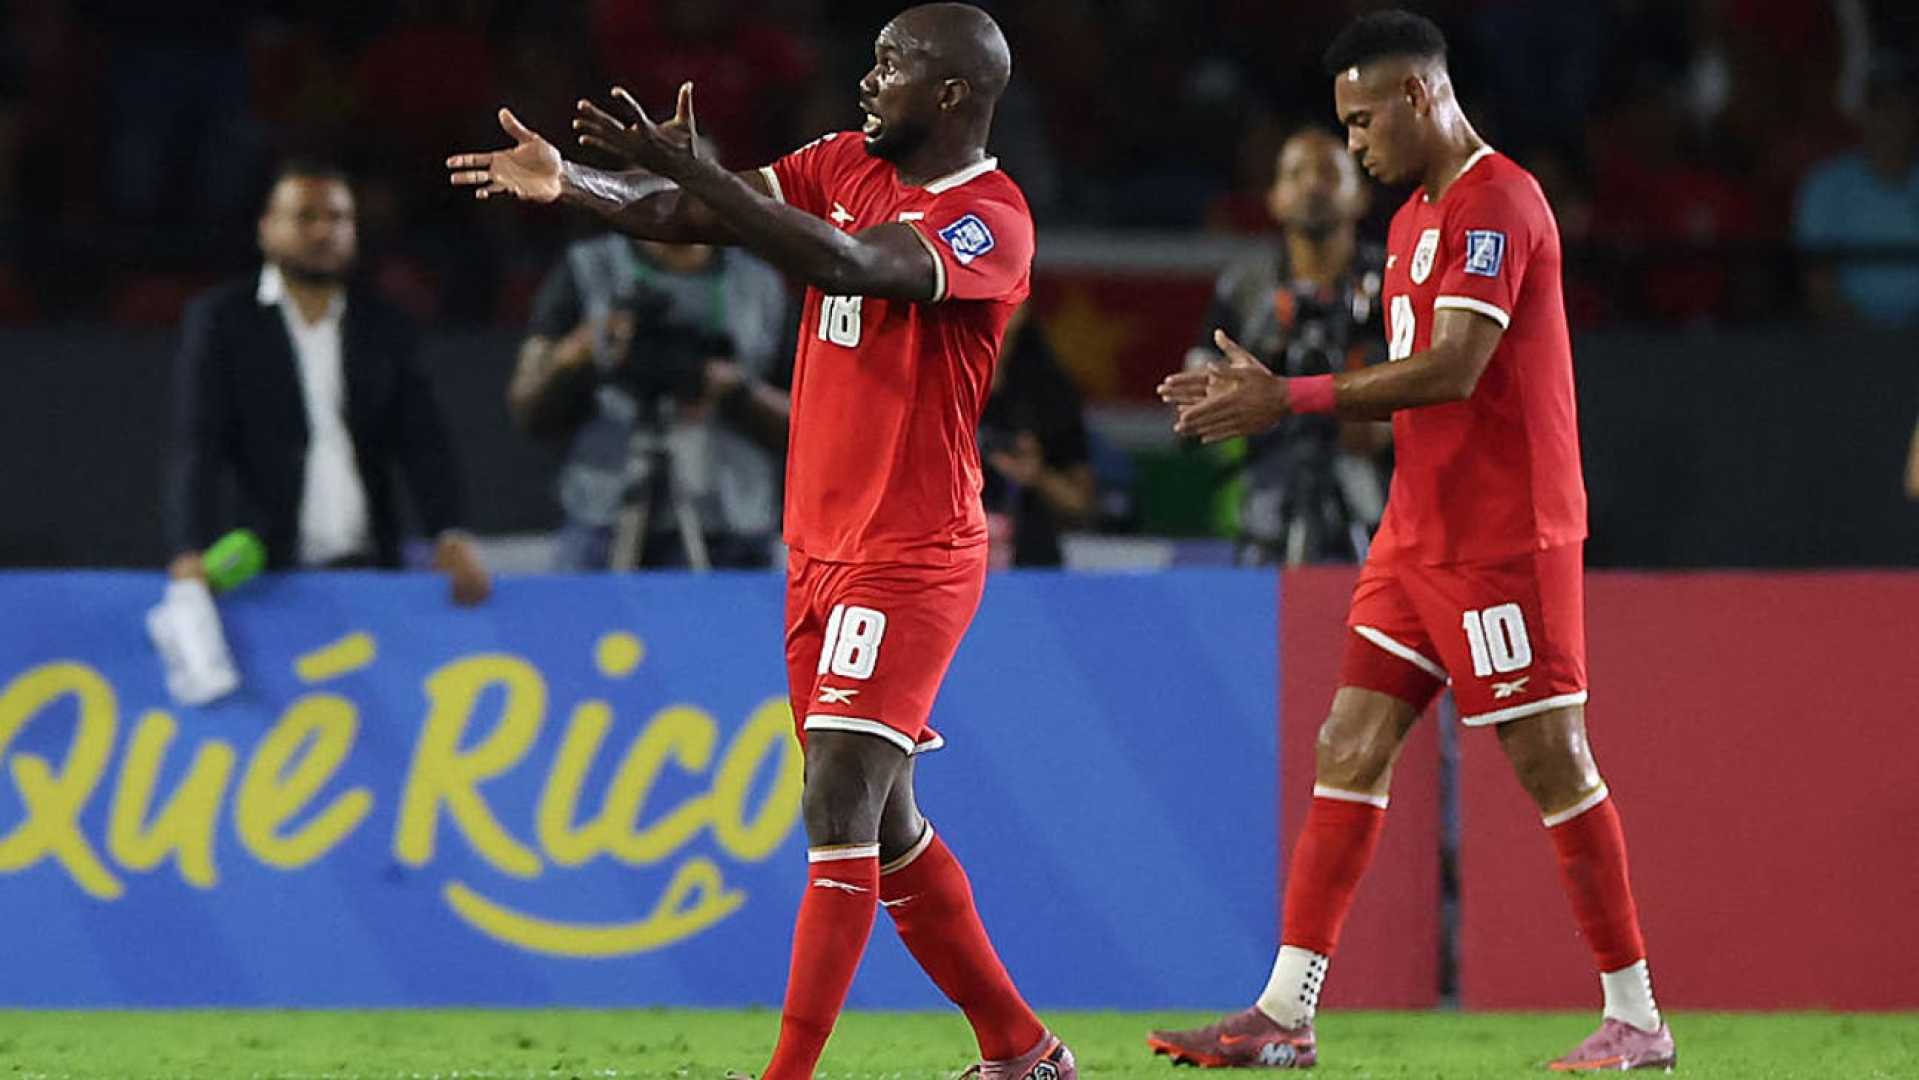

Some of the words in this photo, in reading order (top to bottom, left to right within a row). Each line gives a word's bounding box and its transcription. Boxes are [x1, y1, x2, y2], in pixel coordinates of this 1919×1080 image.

[818, 294, 861, 347] 18
[817, 603, 887, 680] 18
[1463, 603, 1532, 677] 10
[0, 634, 374, 898] Qué
[396, 634, 805, 877] Rico
